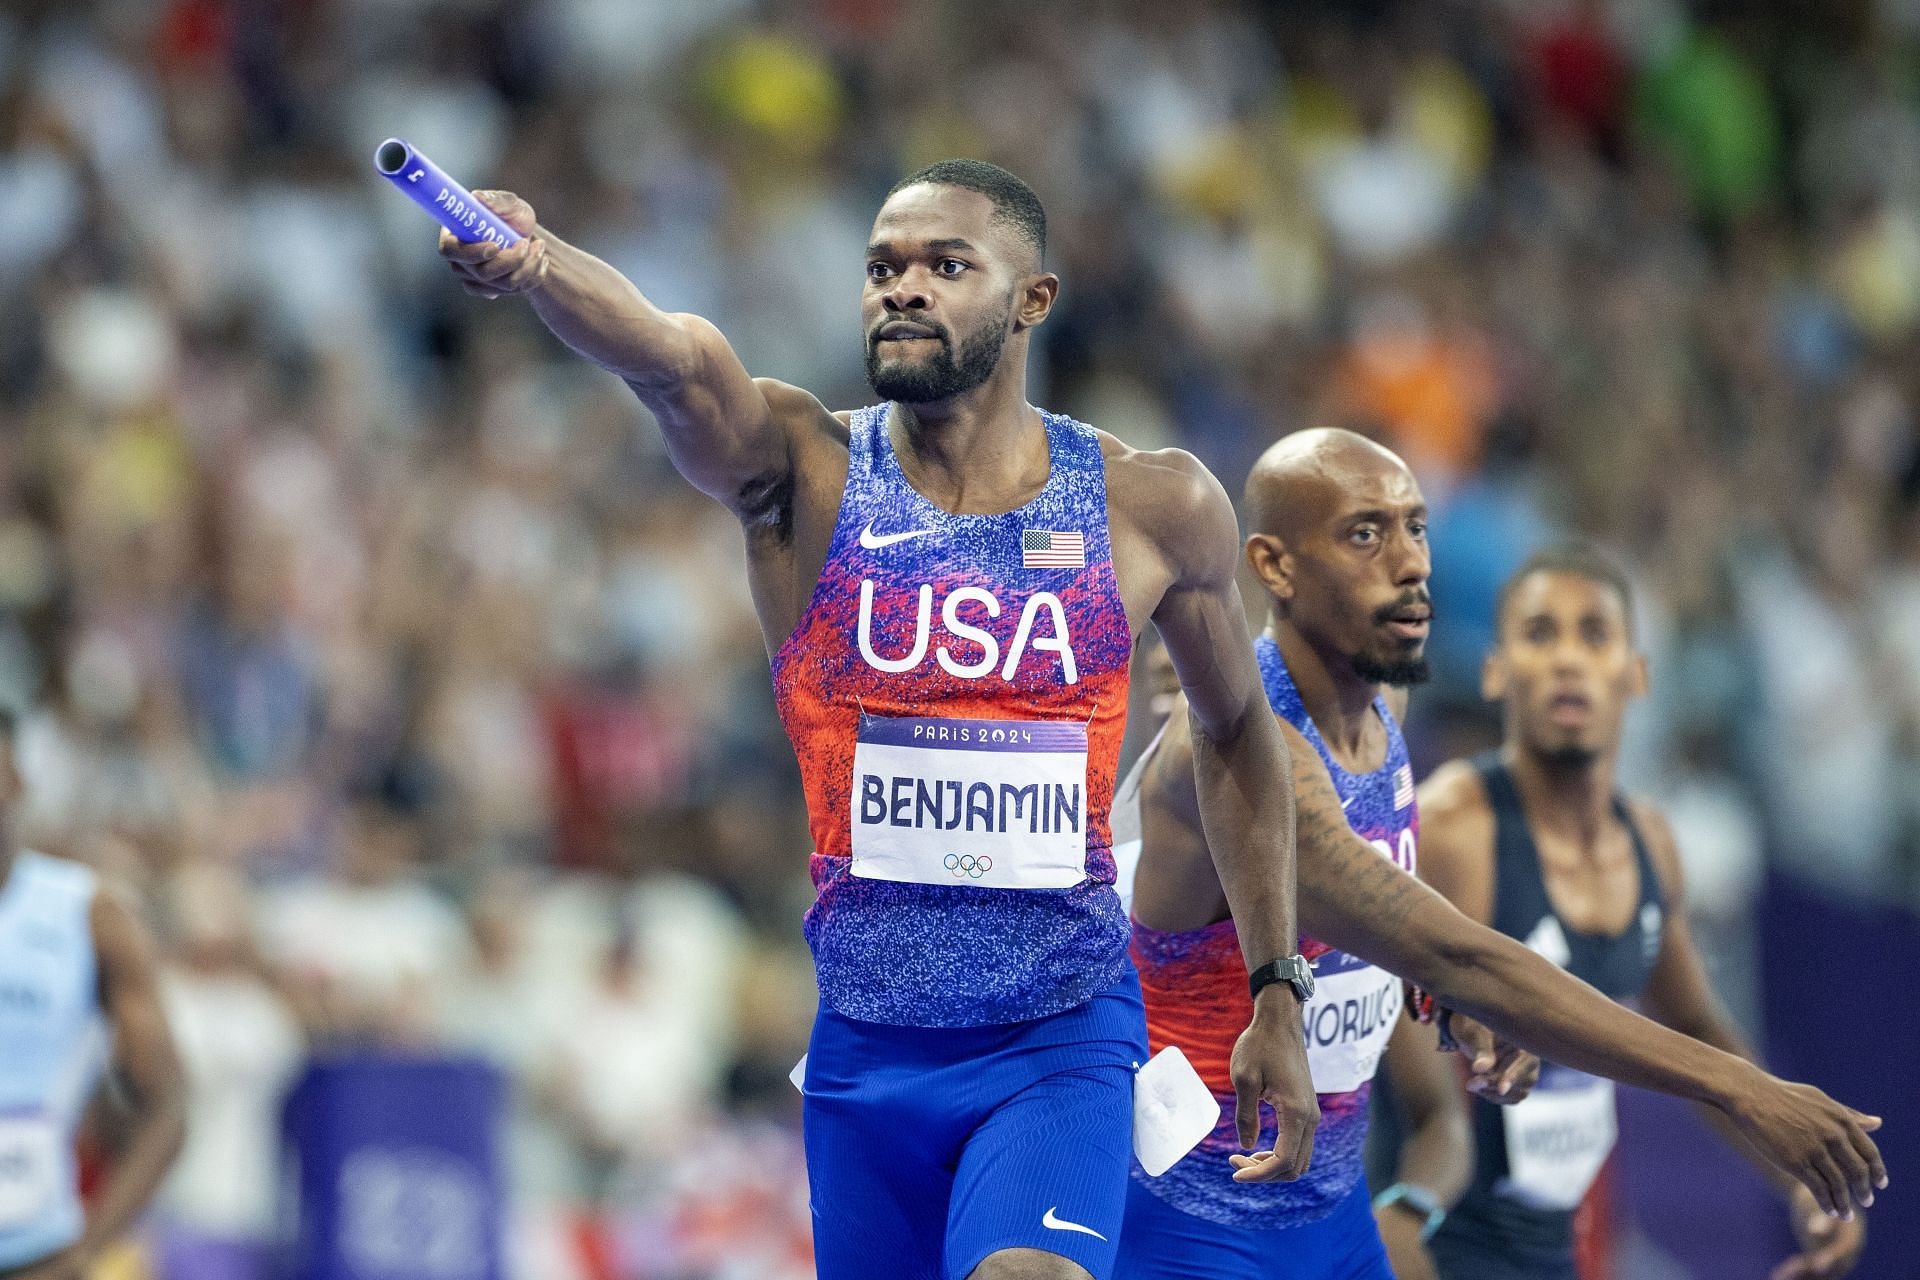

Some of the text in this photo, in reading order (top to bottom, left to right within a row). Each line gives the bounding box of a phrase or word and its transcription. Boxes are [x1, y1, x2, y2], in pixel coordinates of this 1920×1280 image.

[858, 578, 1078, 684] USA
[979, 728, 1032, 744] 2024
[860, 774, 1079, 833] BENJAMIN
